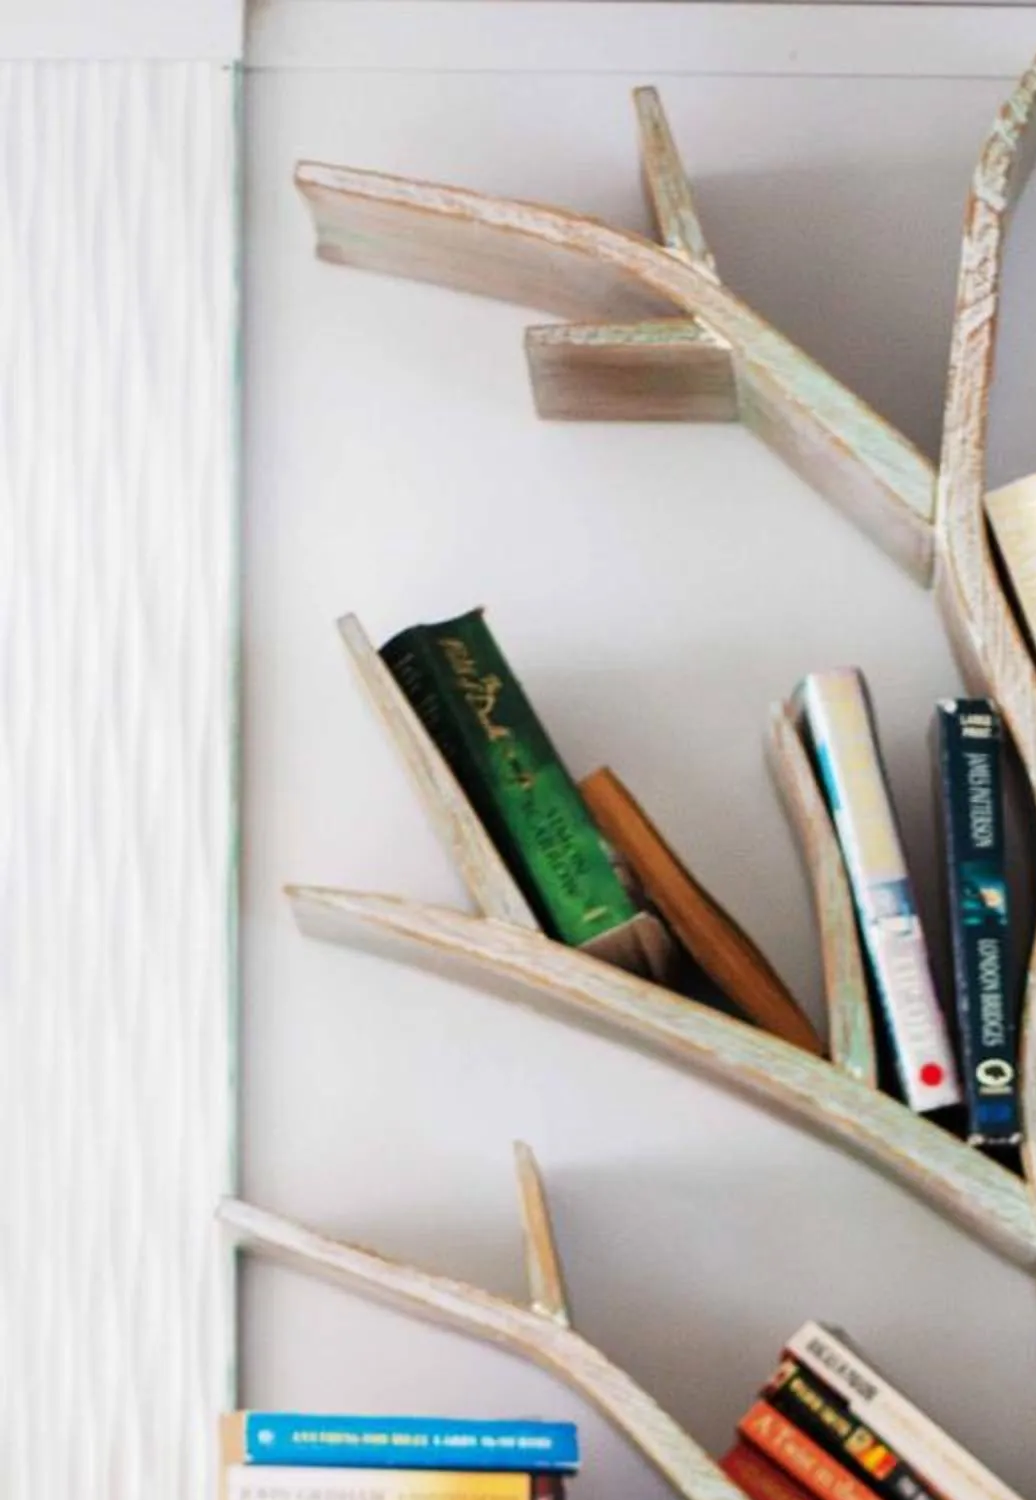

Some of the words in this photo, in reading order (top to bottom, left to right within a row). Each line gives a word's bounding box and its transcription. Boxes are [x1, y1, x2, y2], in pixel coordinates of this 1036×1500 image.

[965, 750, 991, 794] JAMES
[966, 792, 995, 848] PATTERSON
[975, 936, 1003, 990] LONDON
[977, 989, 1007, 1047] BRIDGES
